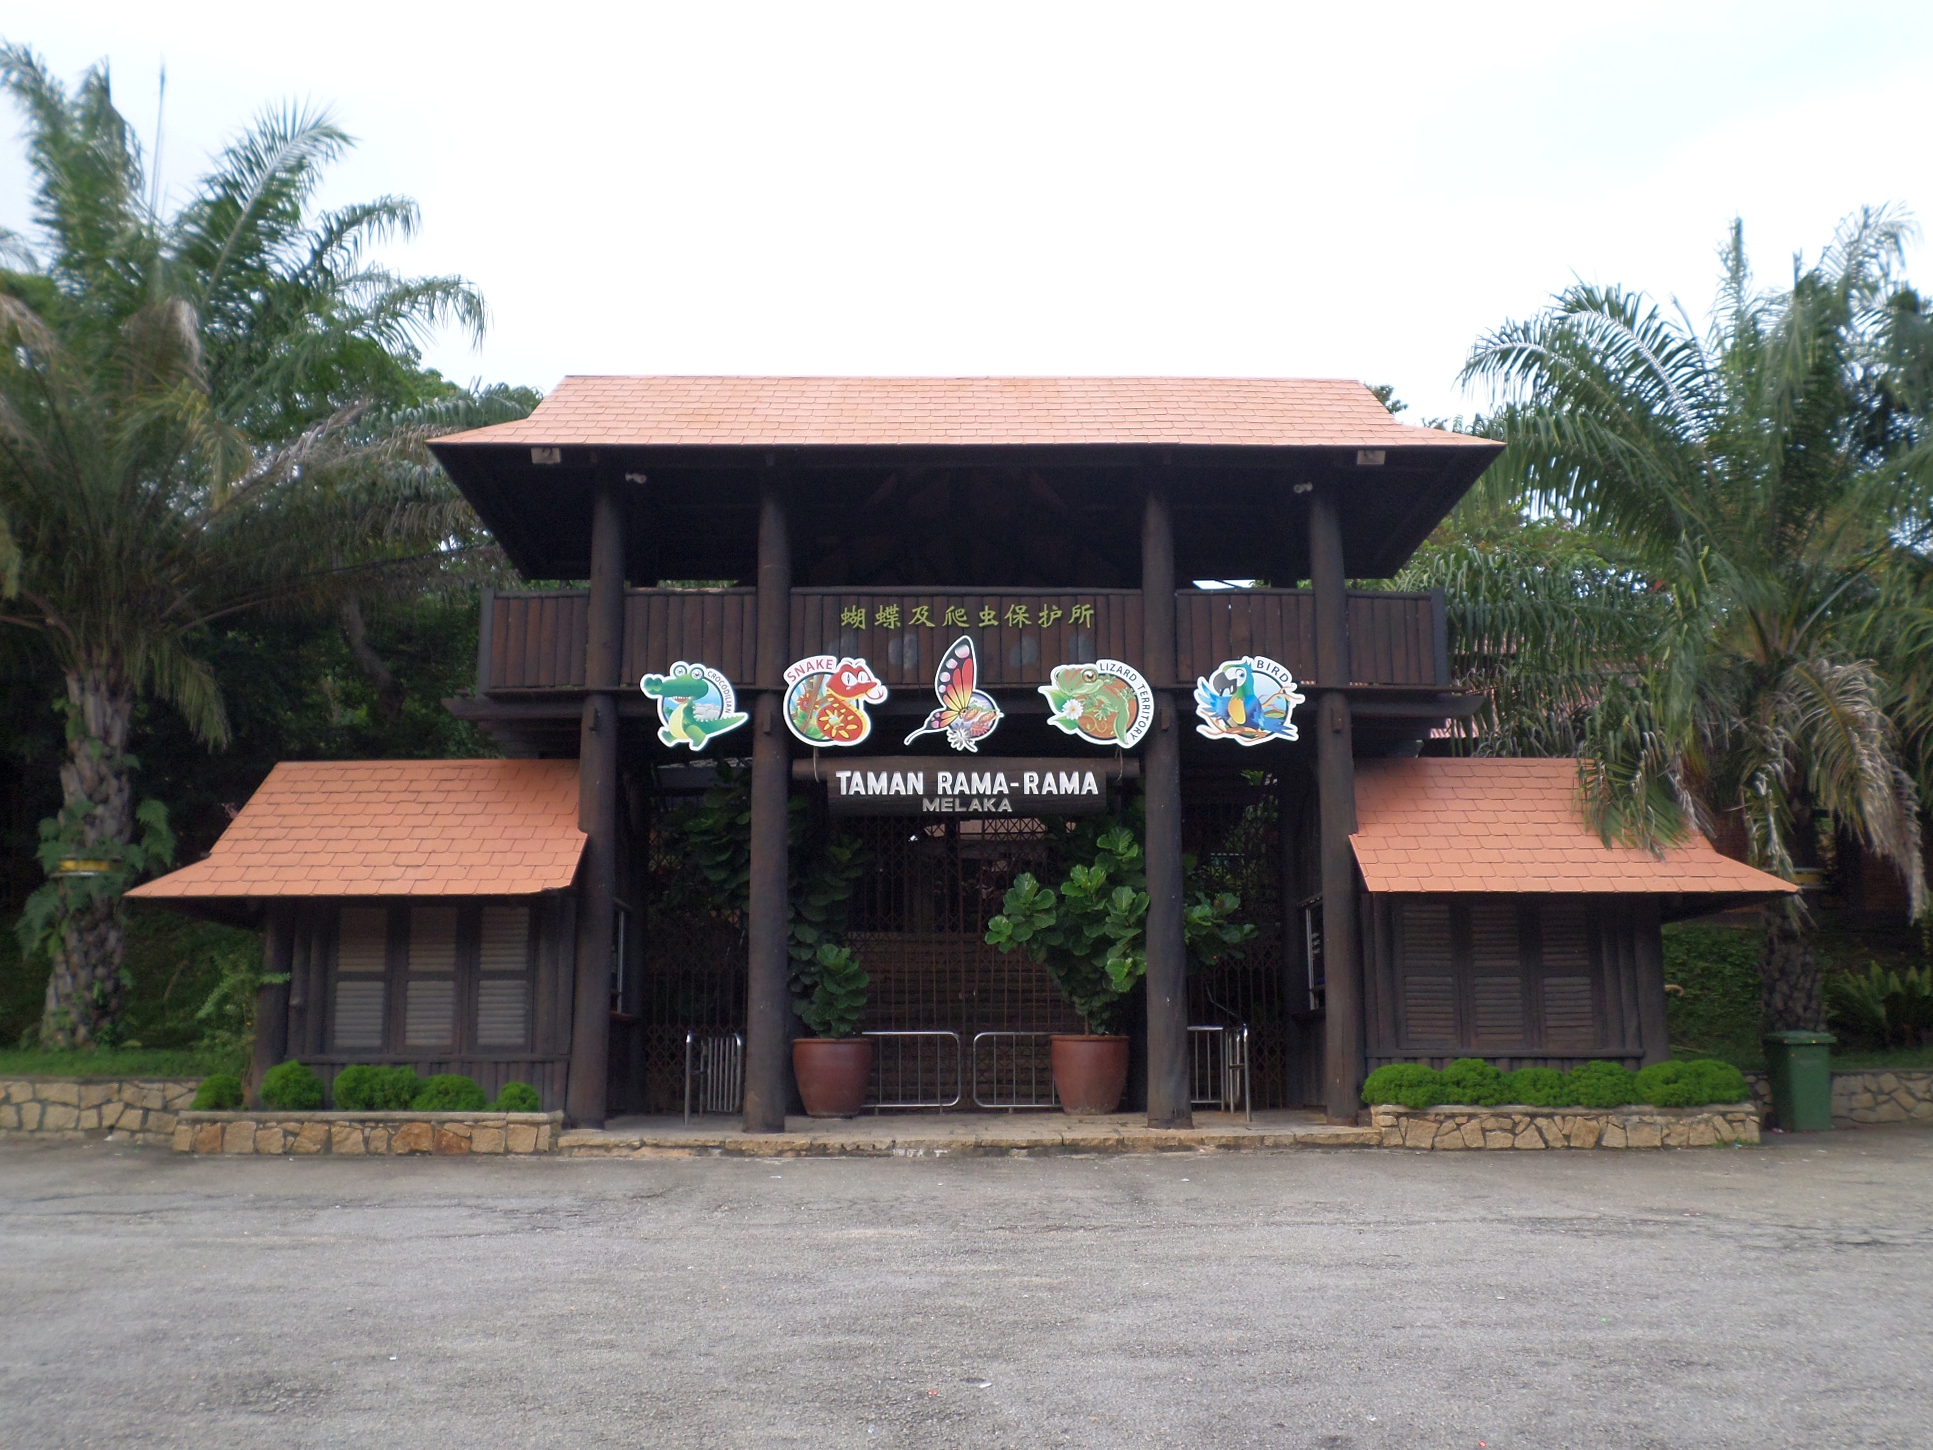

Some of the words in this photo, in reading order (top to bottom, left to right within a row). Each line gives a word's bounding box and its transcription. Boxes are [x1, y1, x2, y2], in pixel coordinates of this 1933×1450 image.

[840, 603, 1095, 629] 蝴蝶及爬虫保护所
[786, 658, 833, 682] SNAKE
[1256, 659, 1289, 683] BIRD
[707, 670, 732, 714] CROCODILIAN
[1099, 662, 1137, 682] LIZARD
[1130, 683, 1151, 741] TERRITORY
[835, 771, 924, 795] TAMAN
[937, 771, 1099, 795] RAMA-RAMA
[922, 797, 1013, 812] MELAKA
